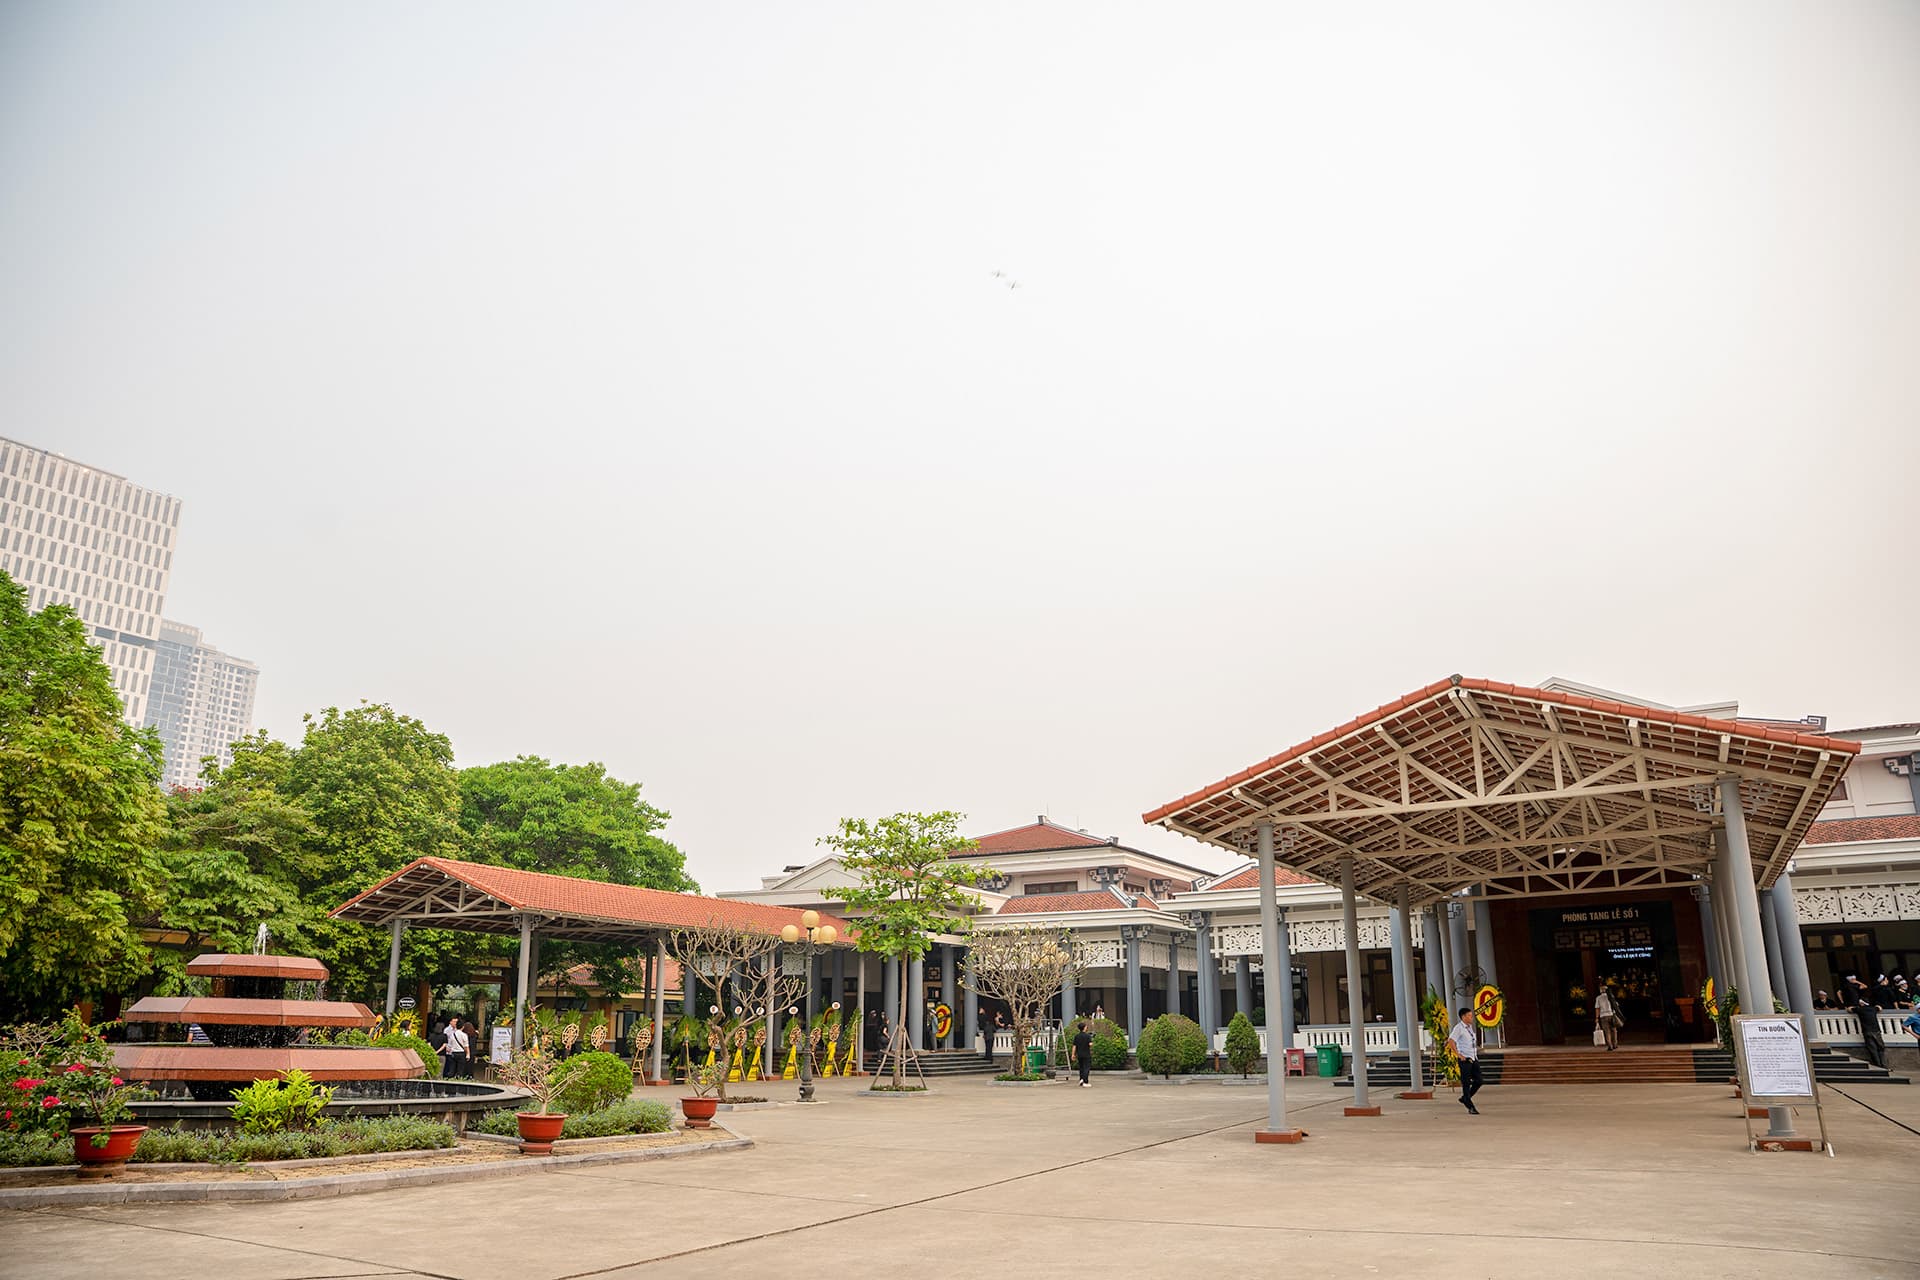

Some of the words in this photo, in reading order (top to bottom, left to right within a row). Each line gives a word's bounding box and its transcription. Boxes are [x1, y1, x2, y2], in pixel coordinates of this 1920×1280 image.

[1562, 912, 1587, 923] PHÒNG
[1589, 911, 1609, 921] TANG
[1623, 907, 1633, 919] SỐ
